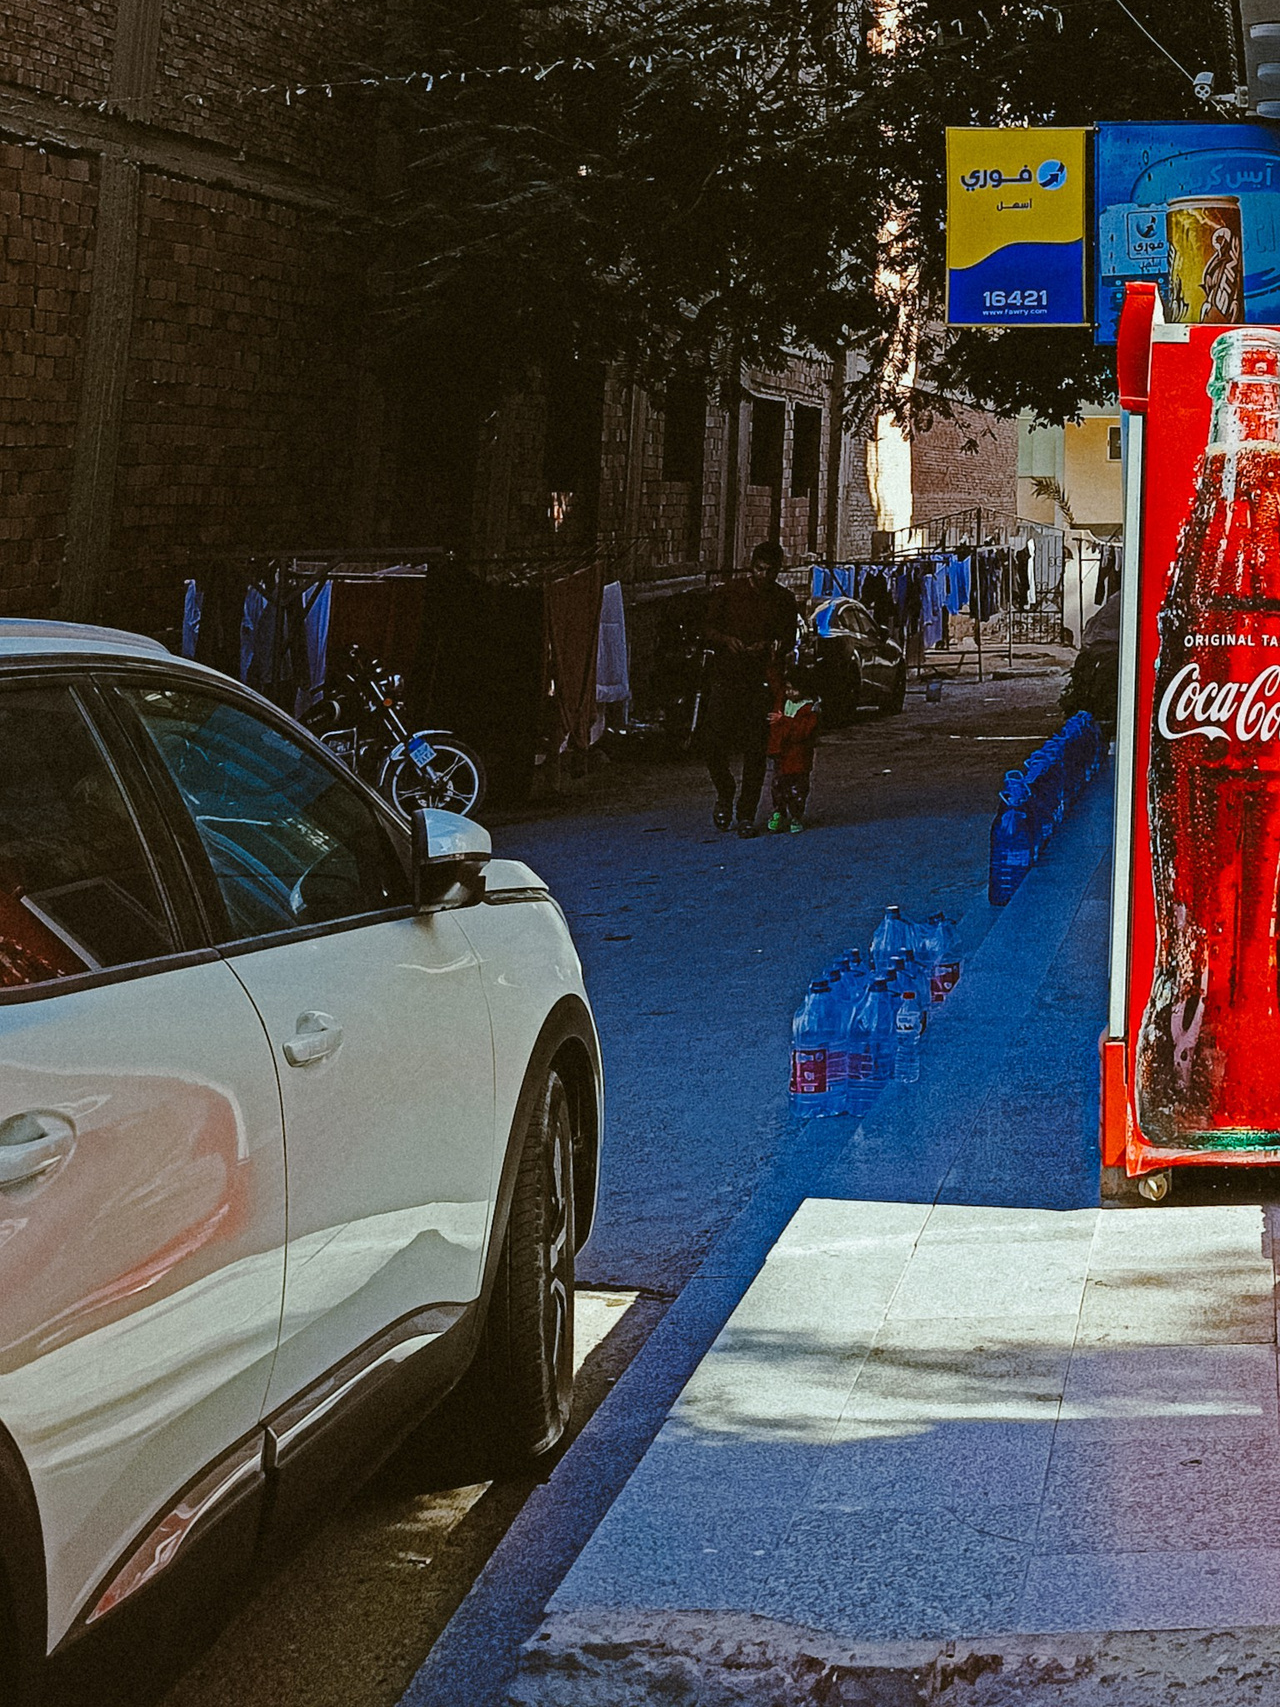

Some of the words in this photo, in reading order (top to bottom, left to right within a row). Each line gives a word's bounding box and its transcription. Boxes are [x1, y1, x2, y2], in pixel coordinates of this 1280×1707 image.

[961, 164, 1033, 192] فوري
[1133, 240, 1165, 254] فوري
[982, 289, 1048, 307] 16421
[982, 308, 1048, 316] www.fawry.com
[1183, 633, 1256, 648] ORIGINAL
